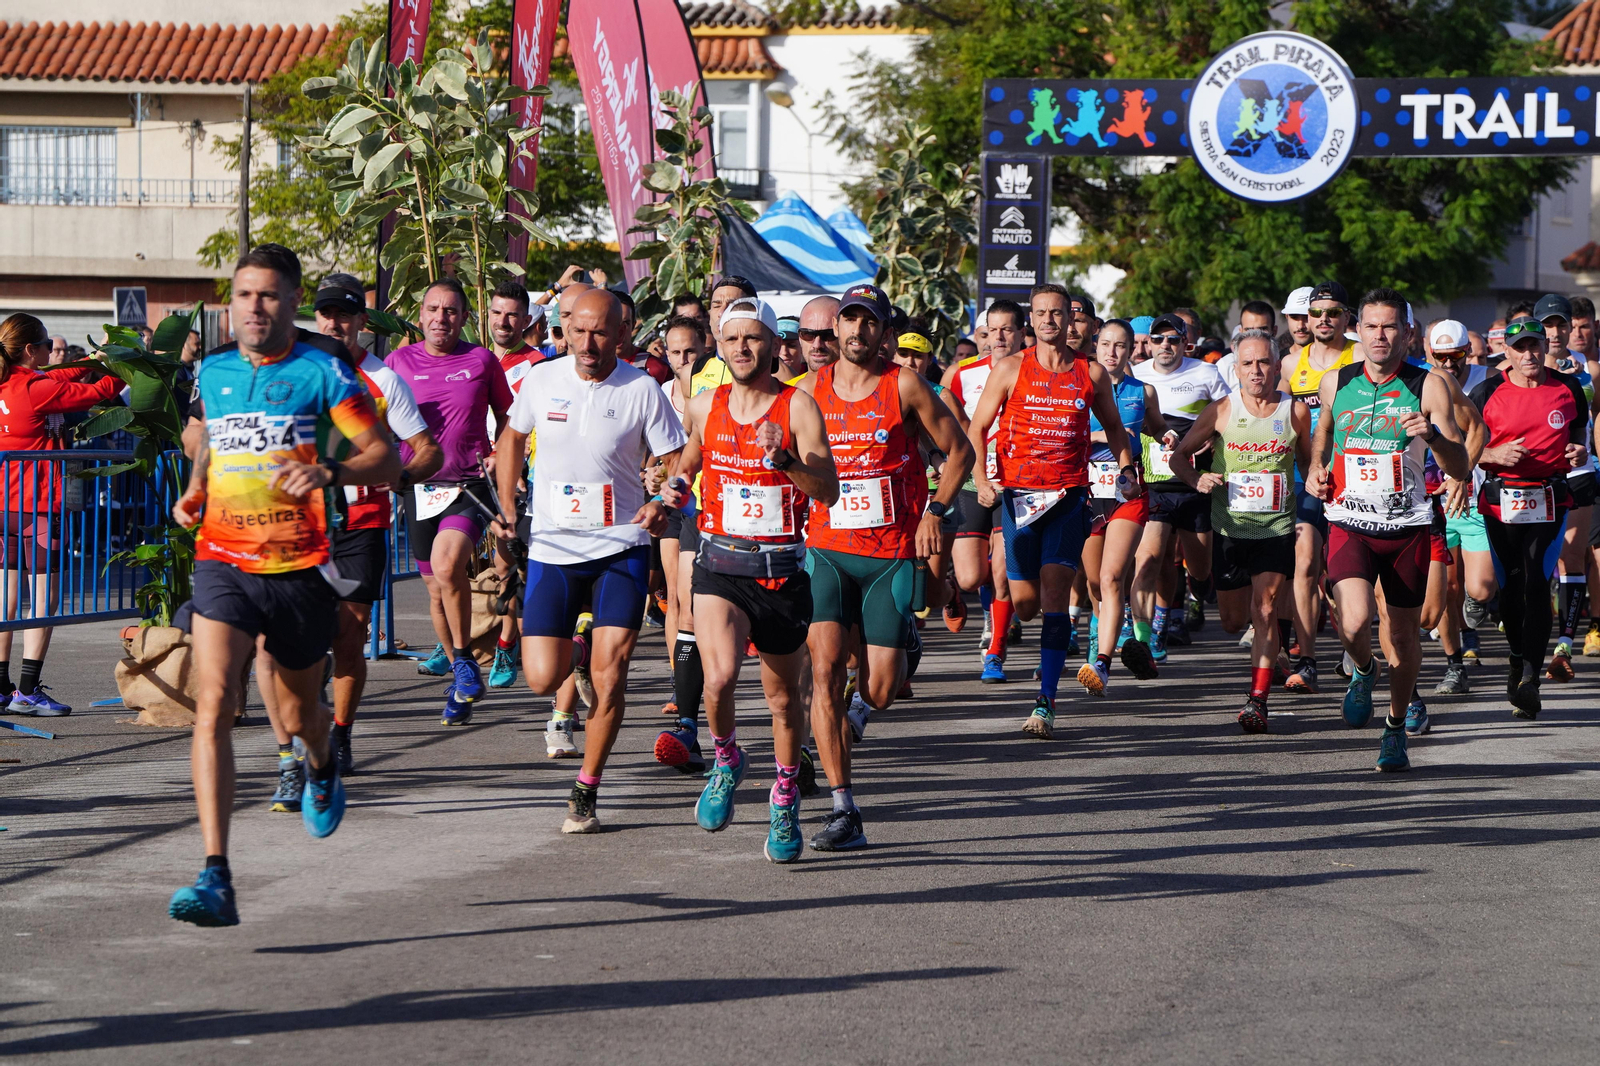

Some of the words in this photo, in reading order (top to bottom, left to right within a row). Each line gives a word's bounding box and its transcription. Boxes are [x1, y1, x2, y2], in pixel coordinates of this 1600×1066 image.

[1206, 45, 1269, 90] TRAIL
[1273, 43, 1345, 103] PIRATA
[1400, 92, 1575, 140] TRAIL
[1320, 128, 1346, 167] 2023
[1199, 120, 1220, 164] SIERRA
[1216, 160, 1239, 182] SAN
[1239, 177, 1306, 192] CRISTOBAL
[991, 235, 1032, 245] INAUTO
[986, 269, 1036, 278] LIBERTIUM
[1025, 394, 1074, 406] Movijerez
[1386, 406, 1412, 415] BIKES
[828, 431, 873, 443] ovijerez
[1345, 437, 1372, 450] GIRON
[1371, 439, 1400, 451] BIKES
[1227, 438, 1293, 455] maratón
[711, 450, 761, 468] Movijerez
[1238, 454, 1281, 463] JEREZ
[1360, 468, 1378, 481] 53
[1393, 459, 1402, 487] PIRATA
[426, 490, 450, 506] 299
[1240, 486, 1265, 498] 250
[571, 498, 581, 513] 2
[604, 490, 613, 522] PIRATA
[840, 495, 871, 511] 155
[881, 484, 892, 517] PIRATA
[1511, 498, 1537, 511] 220
[742, 502, 764, 519] 23
[782, 492, 792, 527] PIRATA
[219, 508, 307, 530] Algeciras
